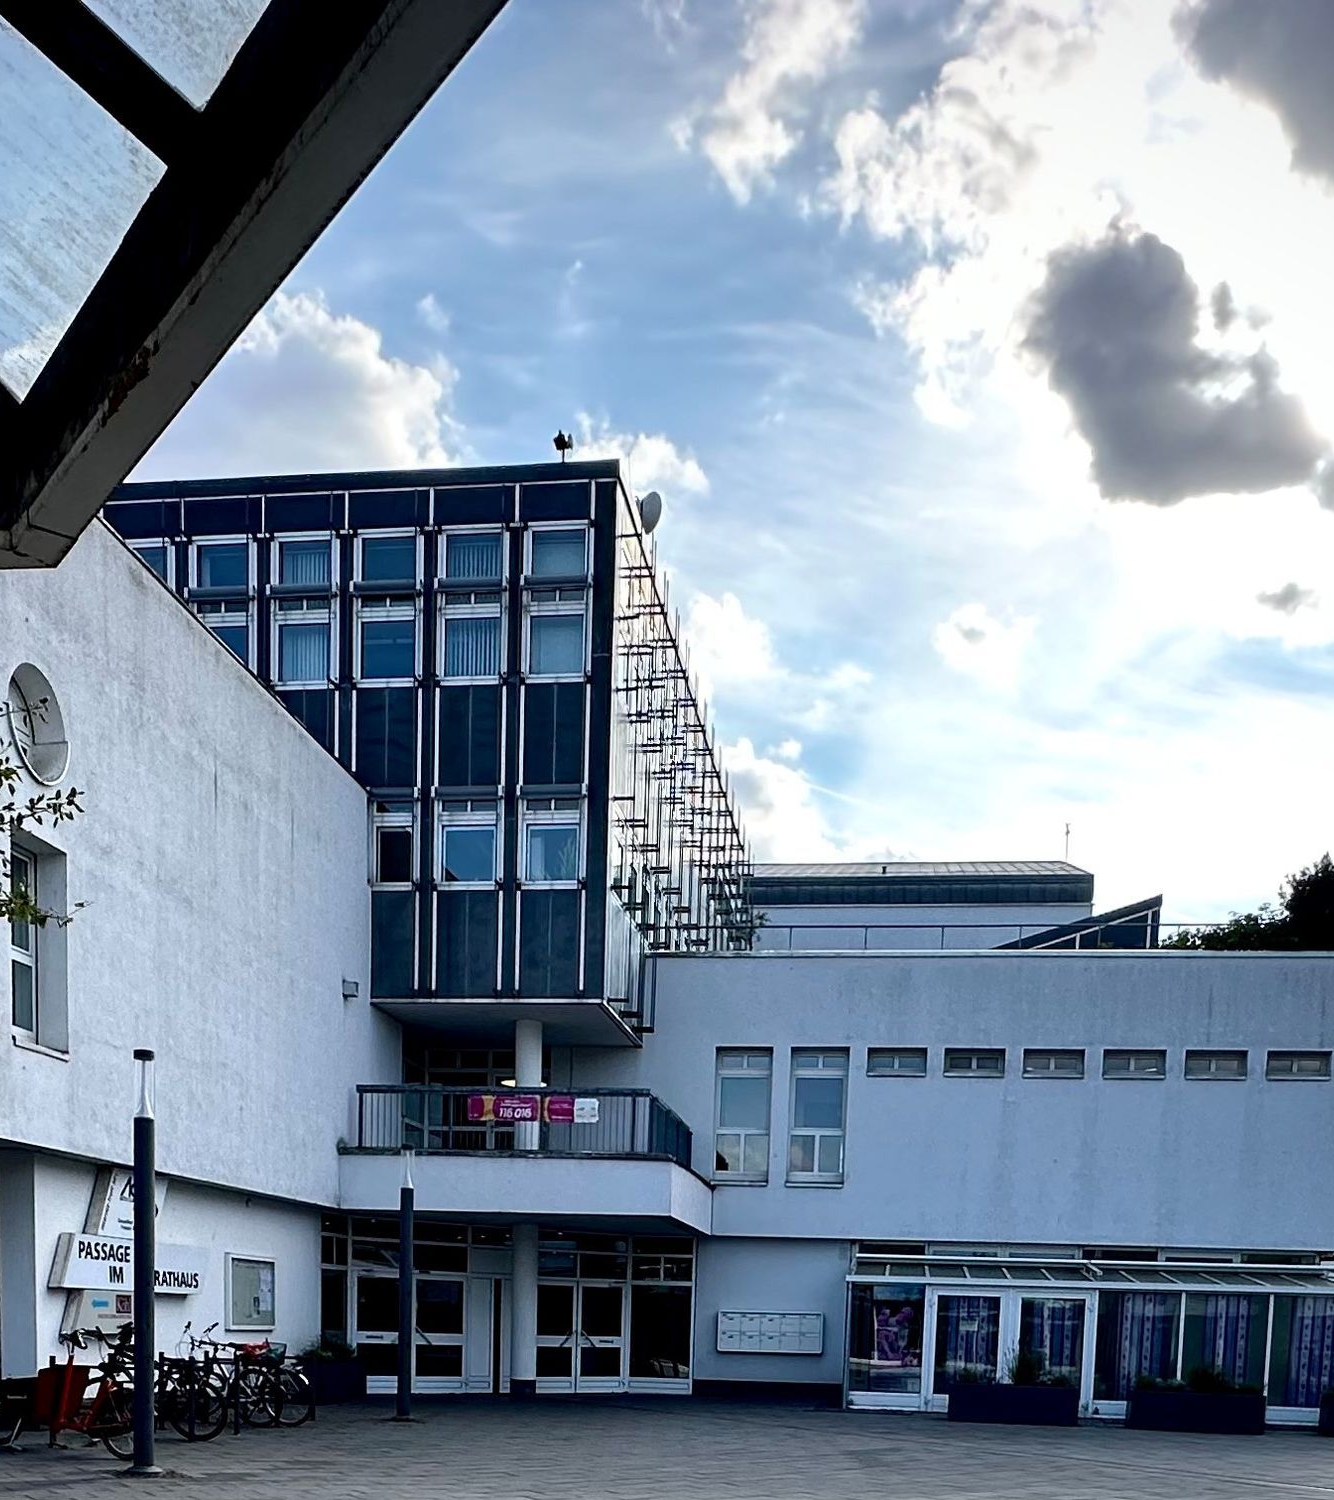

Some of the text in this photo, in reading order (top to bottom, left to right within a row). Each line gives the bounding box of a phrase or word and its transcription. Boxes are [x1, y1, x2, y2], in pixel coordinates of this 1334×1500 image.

[78, 1240, 131, 1263] PASSAGE
[109, 1265, 199, 1289] IM RATHAUS
